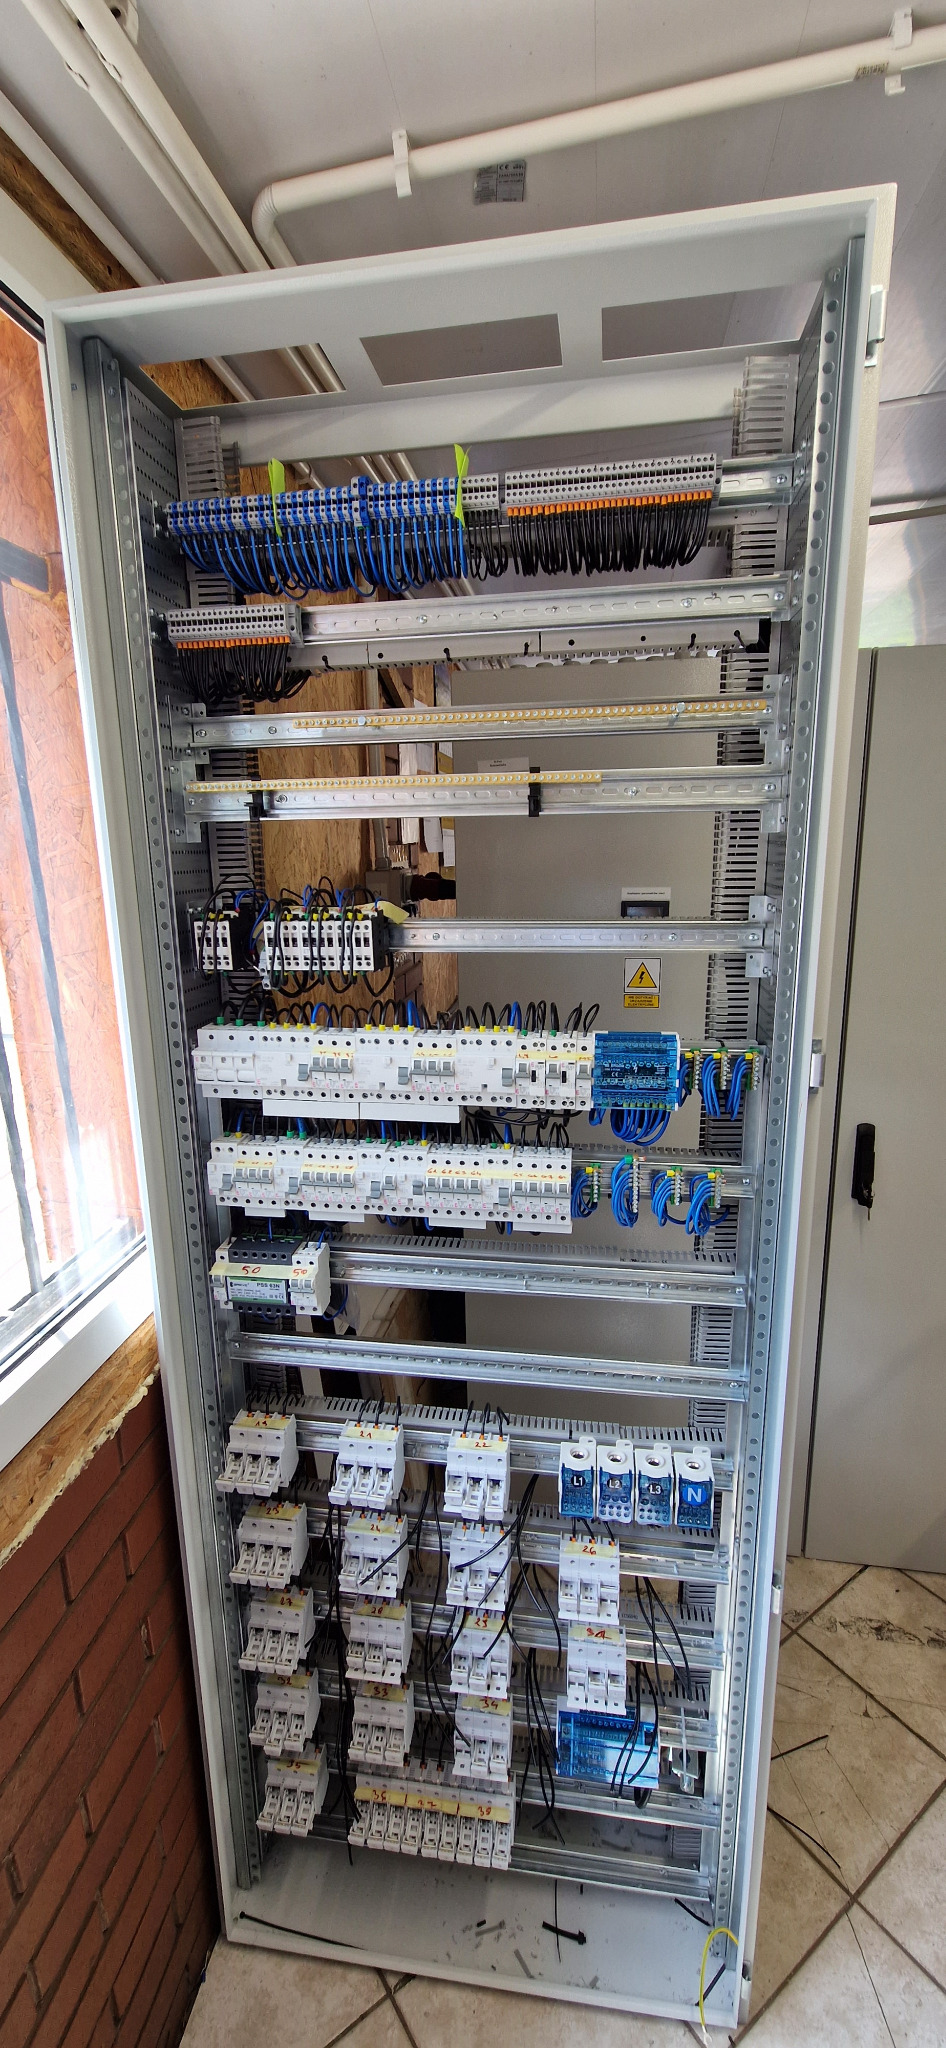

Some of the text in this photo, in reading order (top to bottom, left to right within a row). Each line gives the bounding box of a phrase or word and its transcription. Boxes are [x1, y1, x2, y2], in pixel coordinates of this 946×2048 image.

[242, 1265, 307, 1277] 50 50
[359, 1430, 372, 1439] 21
[573, 1475, 584, 1486] L1
[609, 1478, 621, 1489] L2
[649, 1483, 661, 1495] L3
[687, 1488, 702, 1503] N
[266, 1507, 280, 1515] 23
[581, 1545, 597, 1556] 26
[277, 1675, 292, 1685] 32
[373, 1686, 388, 1697] 33
[480, 1696, 499, 1710] 34
